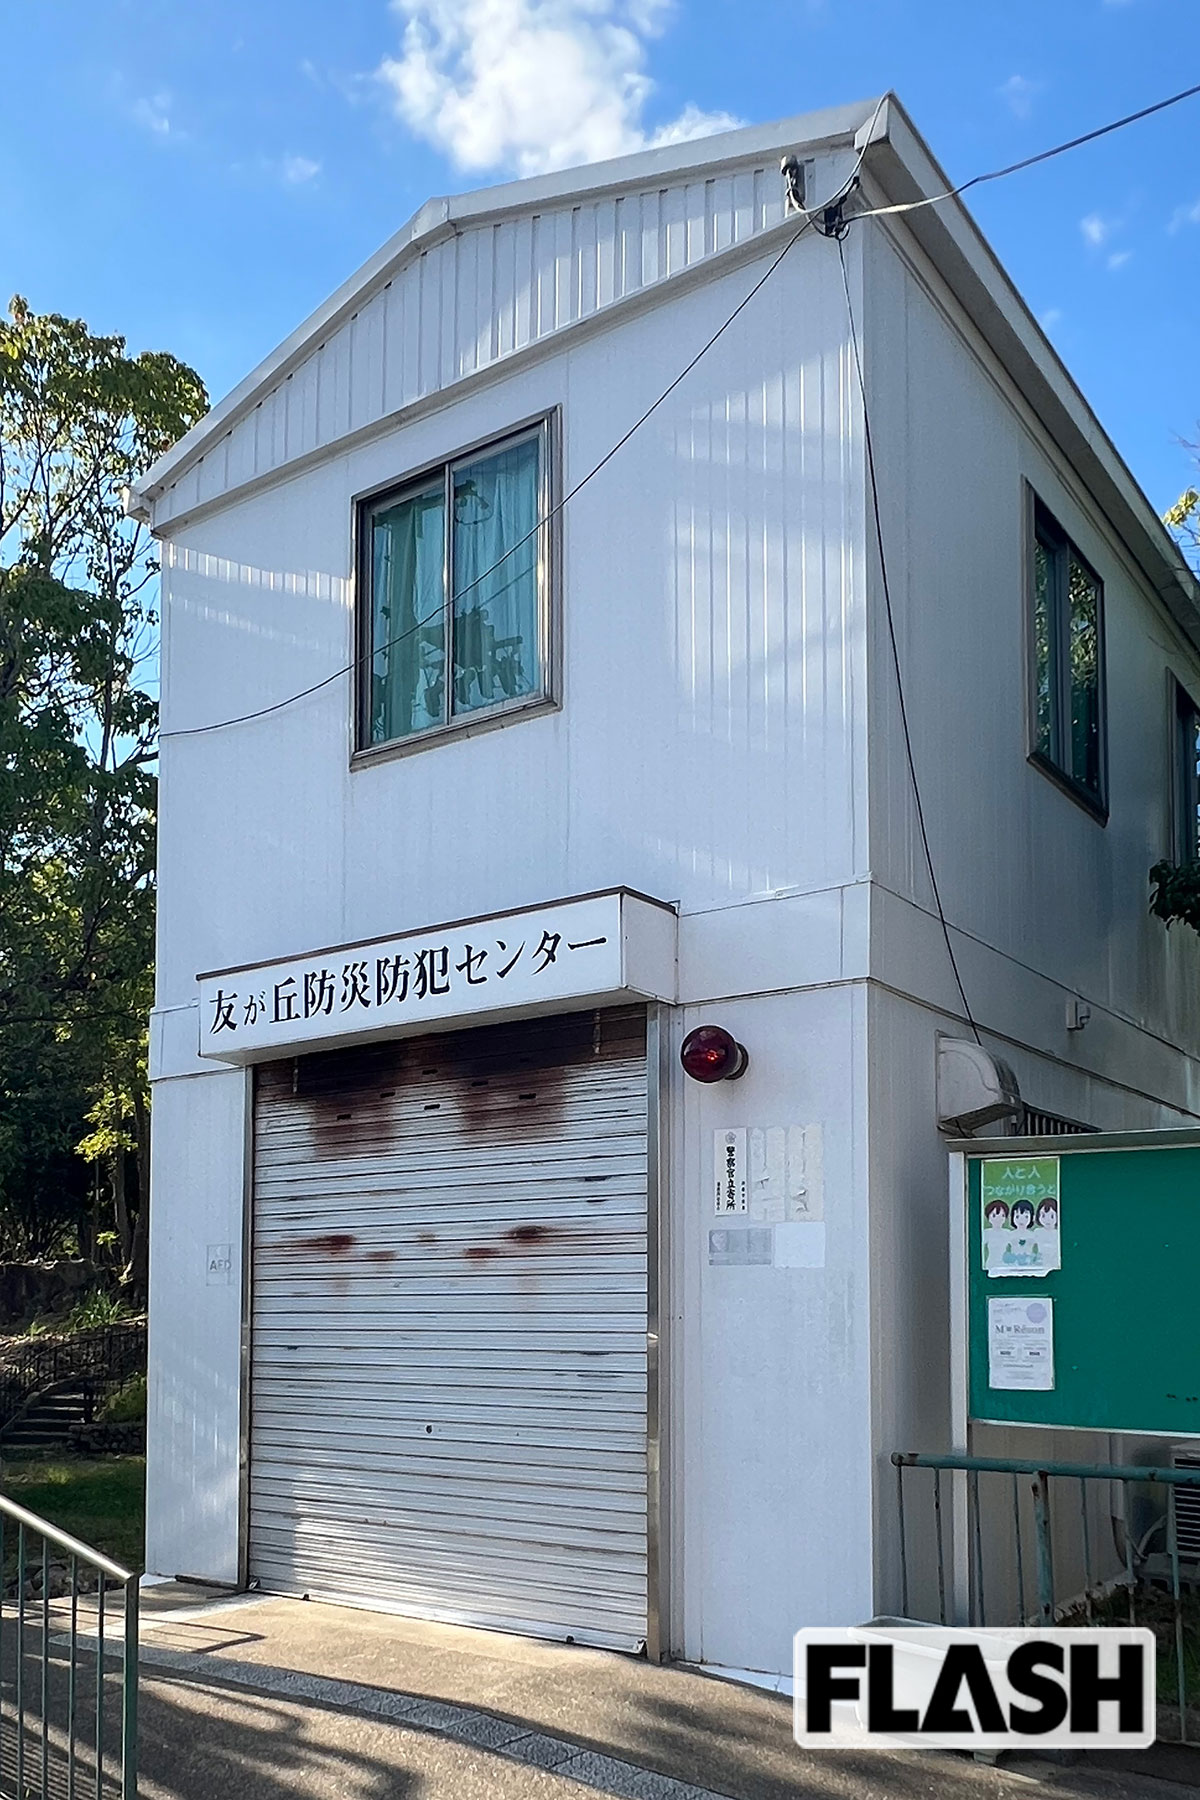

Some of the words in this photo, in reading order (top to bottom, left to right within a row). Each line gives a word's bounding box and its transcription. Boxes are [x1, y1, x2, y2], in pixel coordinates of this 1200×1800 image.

[208, 929, 608, 1035] 友が丘防災防犯センター
[1002, 1165, 1041, 1179] 人と人
